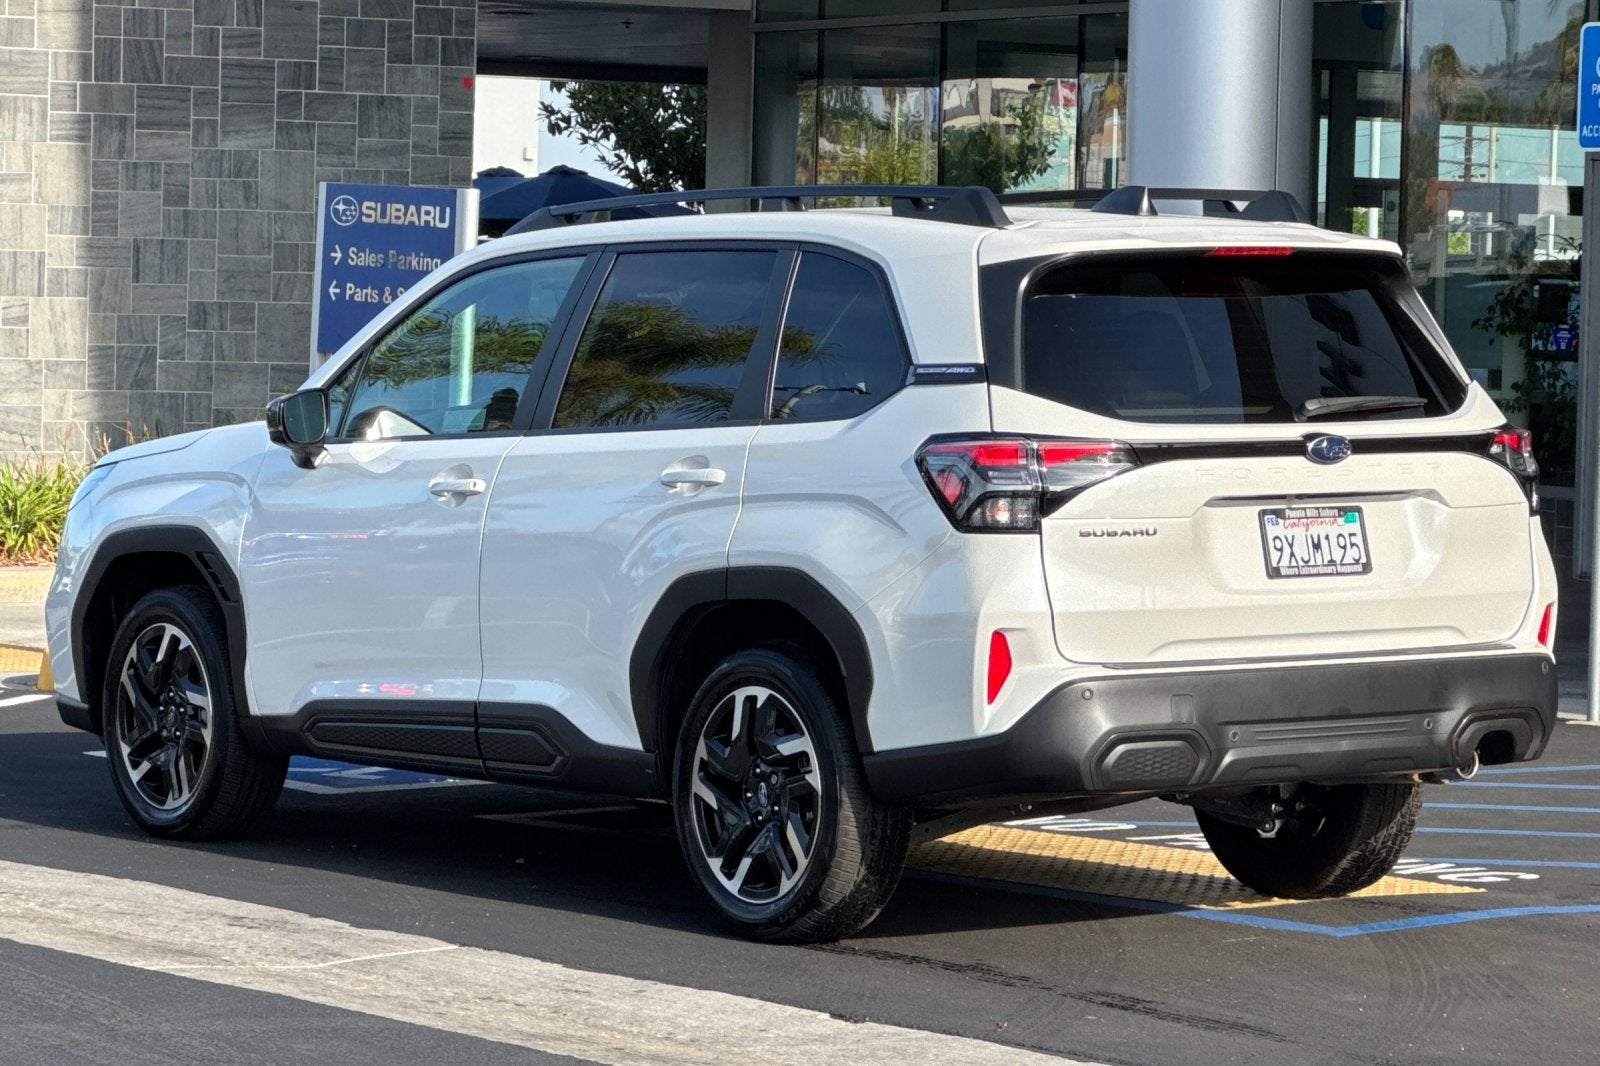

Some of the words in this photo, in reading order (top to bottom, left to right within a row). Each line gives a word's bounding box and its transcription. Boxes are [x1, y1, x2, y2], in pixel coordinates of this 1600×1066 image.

[361, 201, 450, 229] SUBARU
[348, 247, 384, 267] Sales
[388, 250, 441, 272] Parking
[346, 283, 379, 303] Parts
[382, 286, 393, 305] &
[1194, 463, 1443, 482] FORESTER
[1306, 508, 1319, 517] Hills
[1320, 508, 1338, 517] Subaru
[1266, 517, 1280, 526] FEB
[1283, 518, 1343, 533] California
[1079, 527, 1158, 538] SUBARU
[1272, 532, 1362, 566] 9XJM195
[1280, 566, 1299, 576] Where
[1300, 565, 1337, 575] Extraordinary
